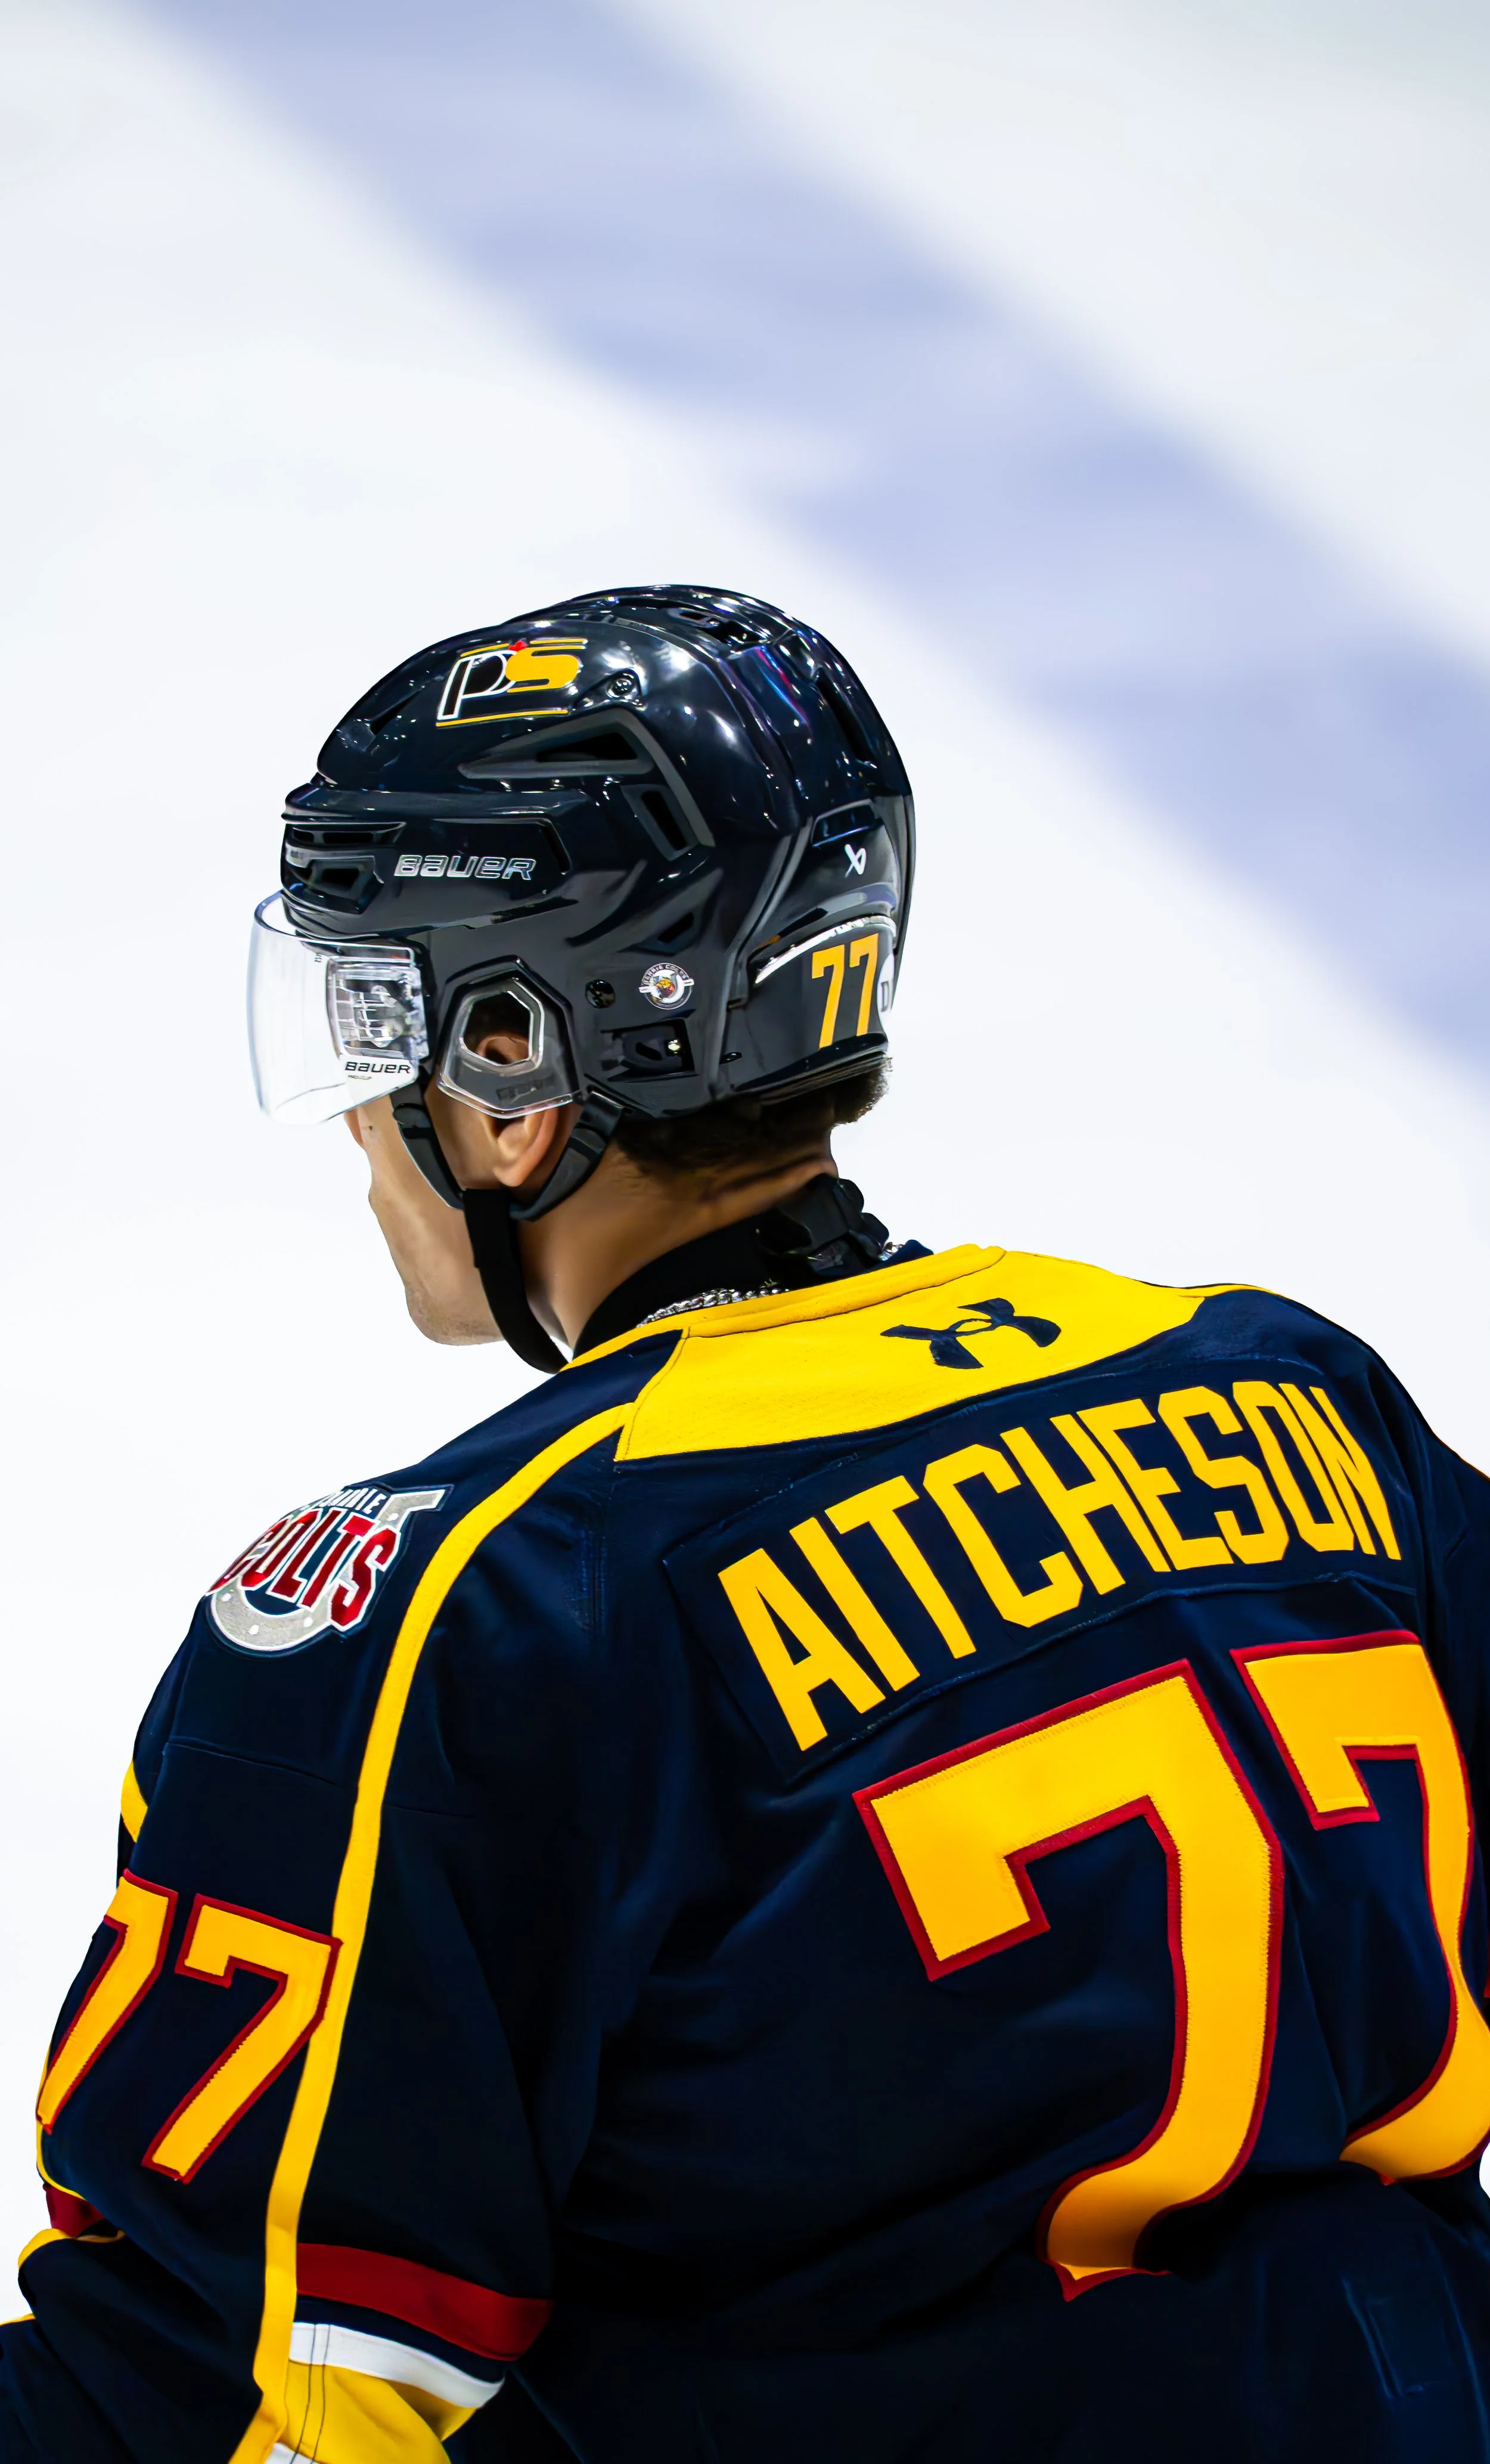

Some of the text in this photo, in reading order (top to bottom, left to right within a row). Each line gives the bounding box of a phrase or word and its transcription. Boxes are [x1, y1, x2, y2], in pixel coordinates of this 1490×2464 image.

[394, 854, 537, 881] BAUER
[344, 1061, 411, 1074] BAUER
[811, 932, 879, 1050] 77
[717, 1381, 1402, 1752] AITCHESON
[35, 1868, 344, 2184] 77
[852, 1628, 1490, 2302] 77
